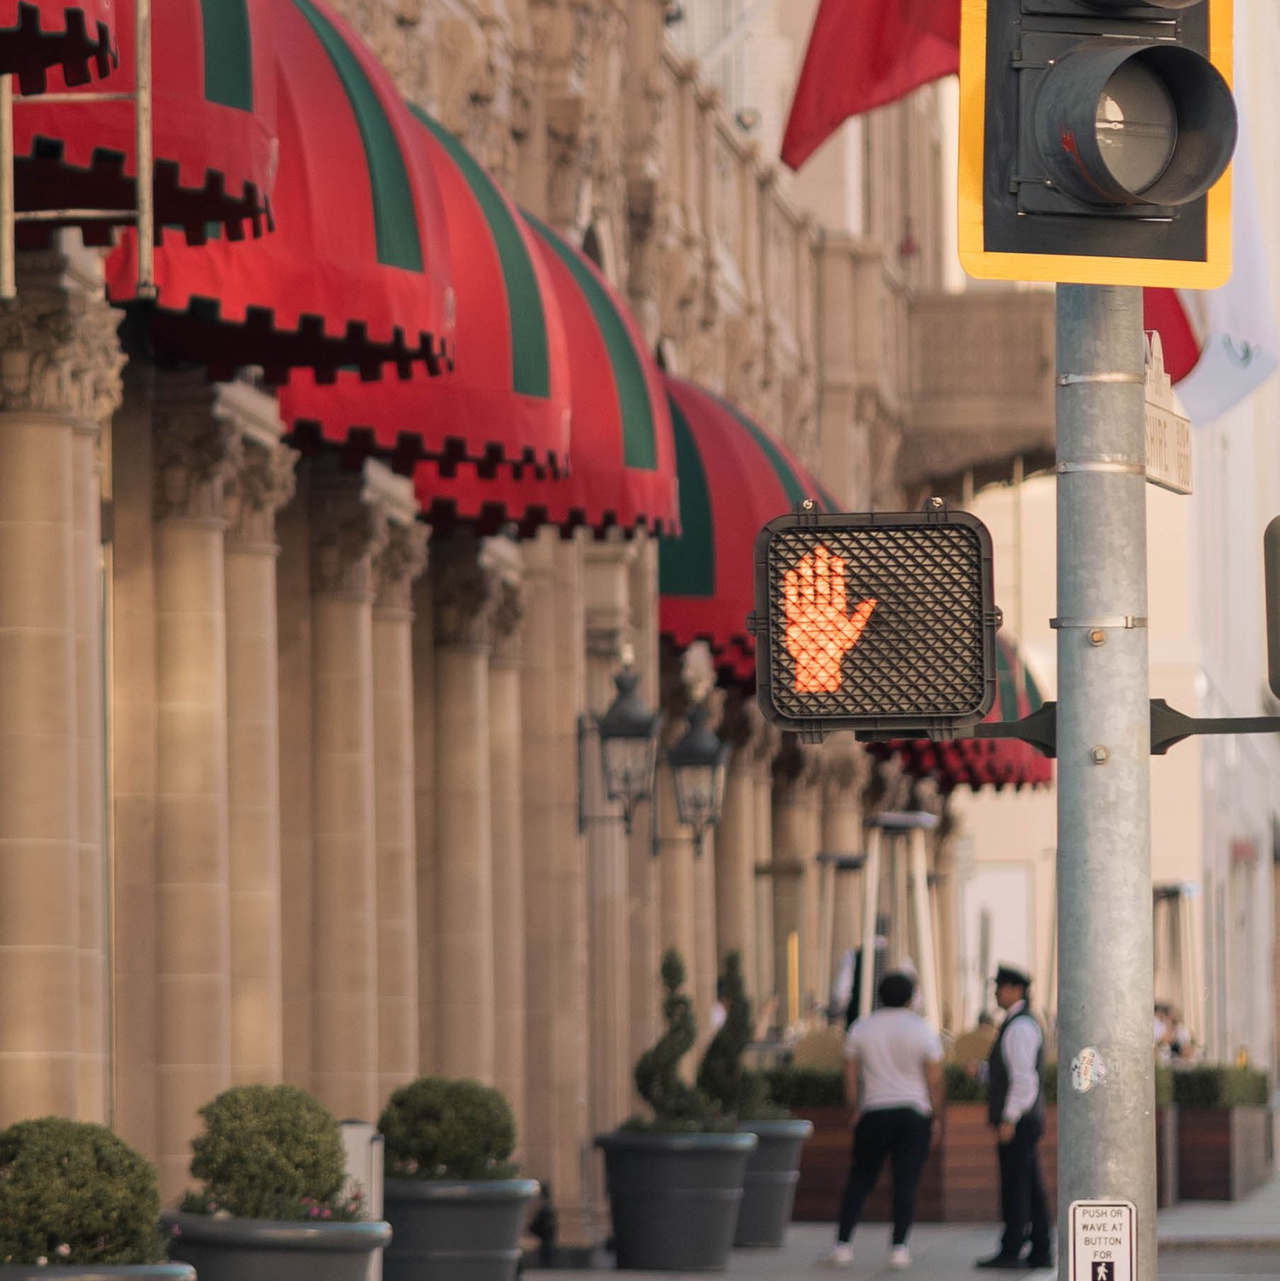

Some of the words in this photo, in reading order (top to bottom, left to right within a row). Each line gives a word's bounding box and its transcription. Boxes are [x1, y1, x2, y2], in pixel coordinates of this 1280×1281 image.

[1145, 414, 1169, 472] SHIRE
[1082, 1209, 1107, 1218] PUSH
[1110, 1209, 1123, 1218] OR
[1082, 1223, 1108, 1231] WAVE
[1111, 1223, 1123, 1231] AT
[1084, 1237, 1121, 1245] BUTTON
[1093, 1251, 1112, 1259] FOR
